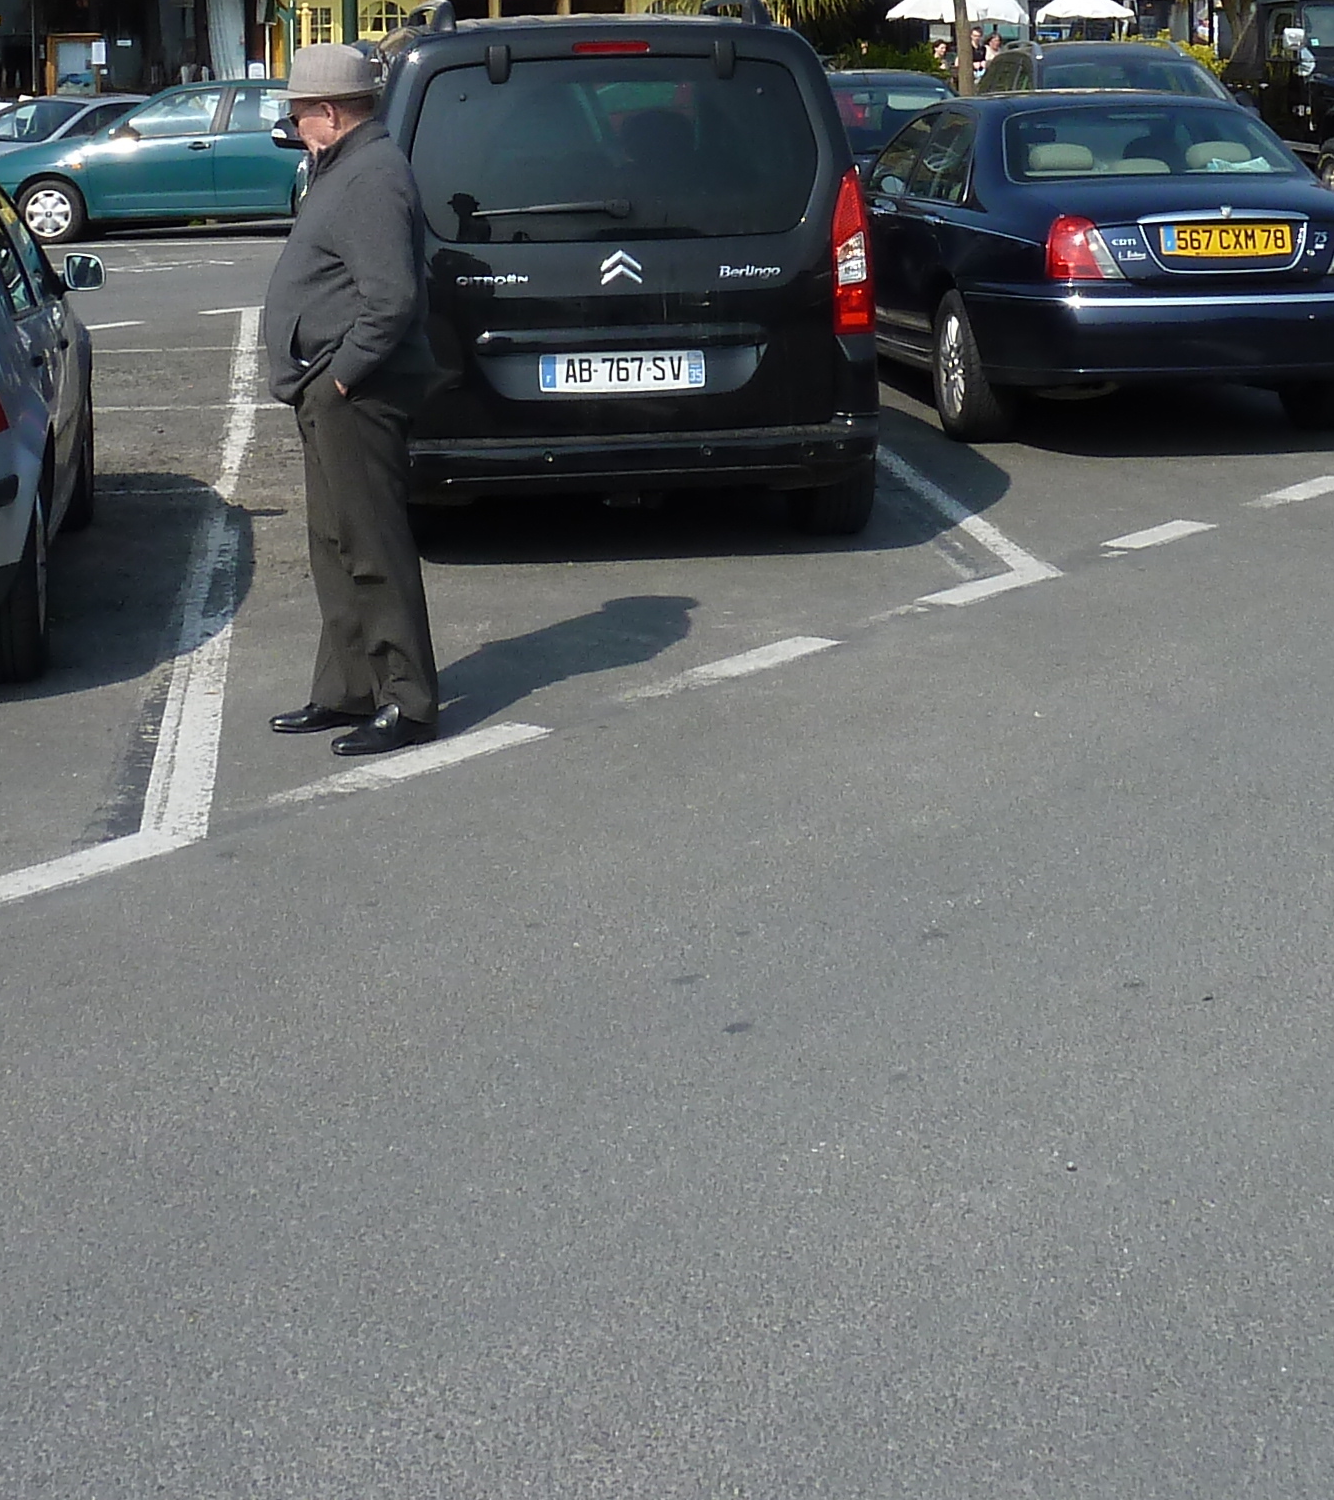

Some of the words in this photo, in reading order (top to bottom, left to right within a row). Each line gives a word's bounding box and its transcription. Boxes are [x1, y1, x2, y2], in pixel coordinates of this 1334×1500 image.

[1177, 230, 1212, 250] 567
[1219, 230, 1256, 249] CXM
[1261, 229, 1285, 249] 78
[719, 264, 781, 280] Berlingo
[689, 368, 703, 381] 35
